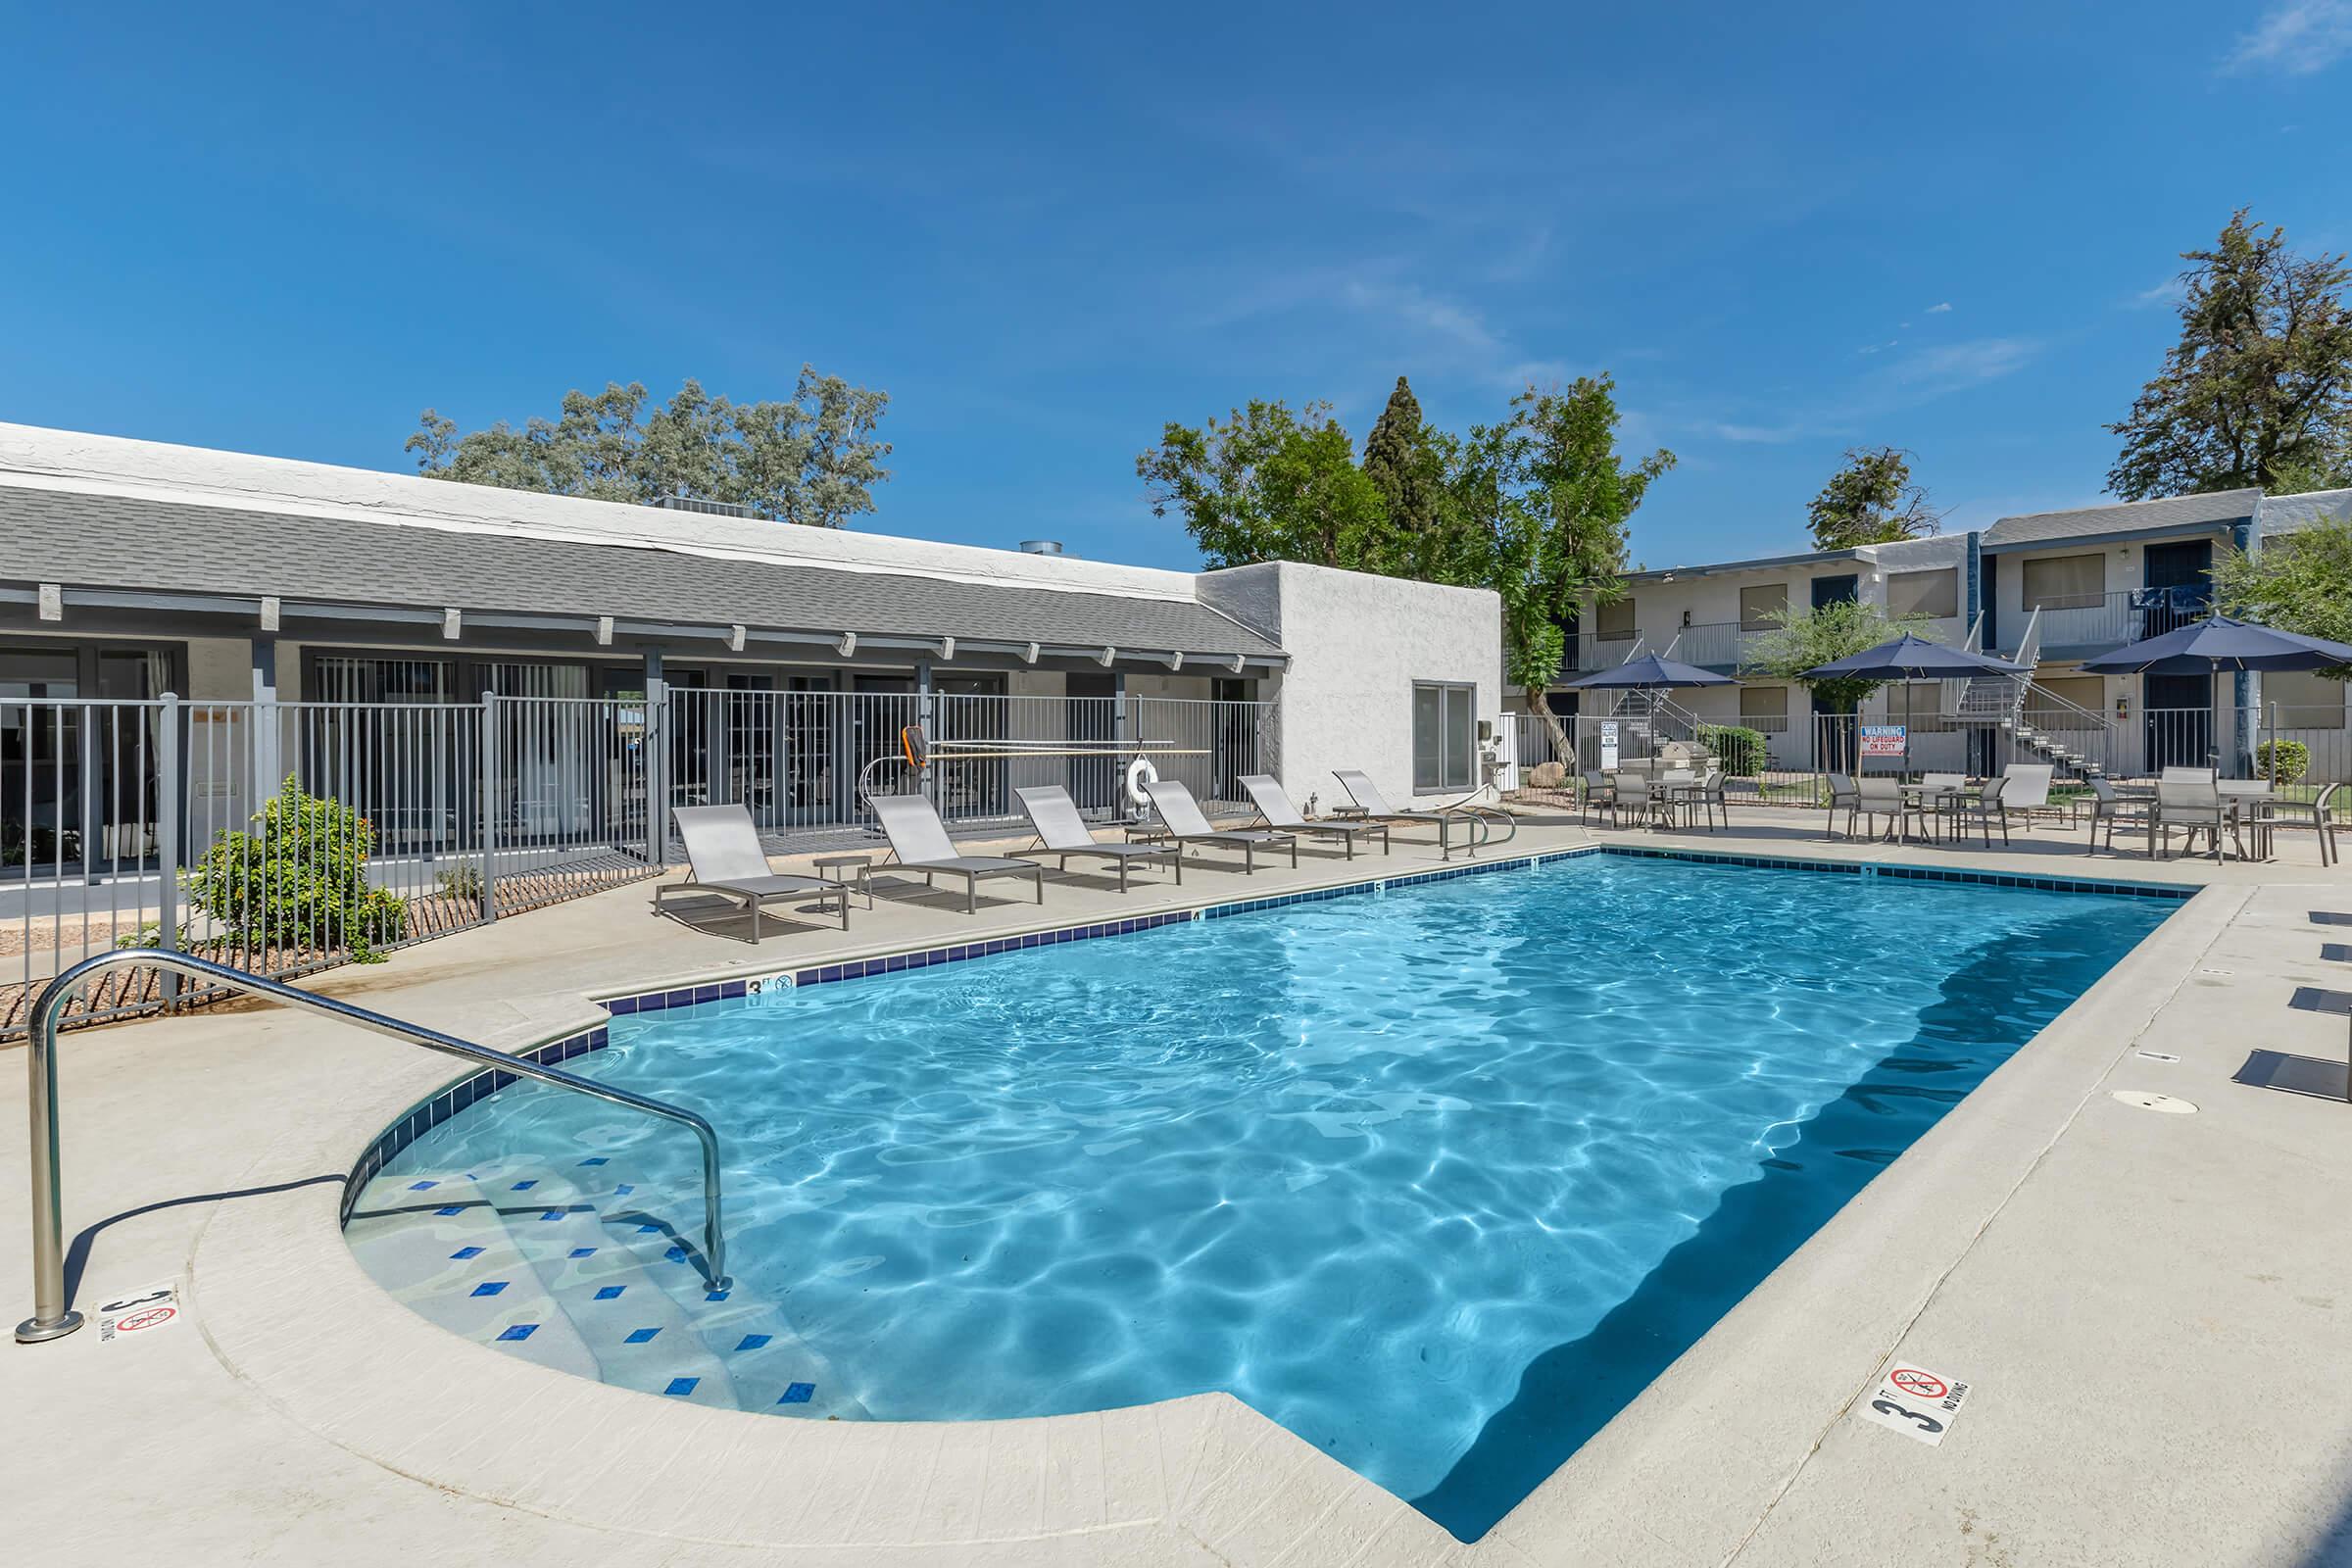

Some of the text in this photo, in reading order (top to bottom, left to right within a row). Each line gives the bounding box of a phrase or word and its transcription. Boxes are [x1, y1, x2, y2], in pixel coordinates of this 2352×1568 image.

[1865, 727, 1902, 736] WARNING
[750, 981, 761, 995] 3
[101, 1291, 172, 1311] 3
[1941, 1382, 1968, 1411] NO DIVING
[1872, 1389, 1943, 1433] 3 FT
